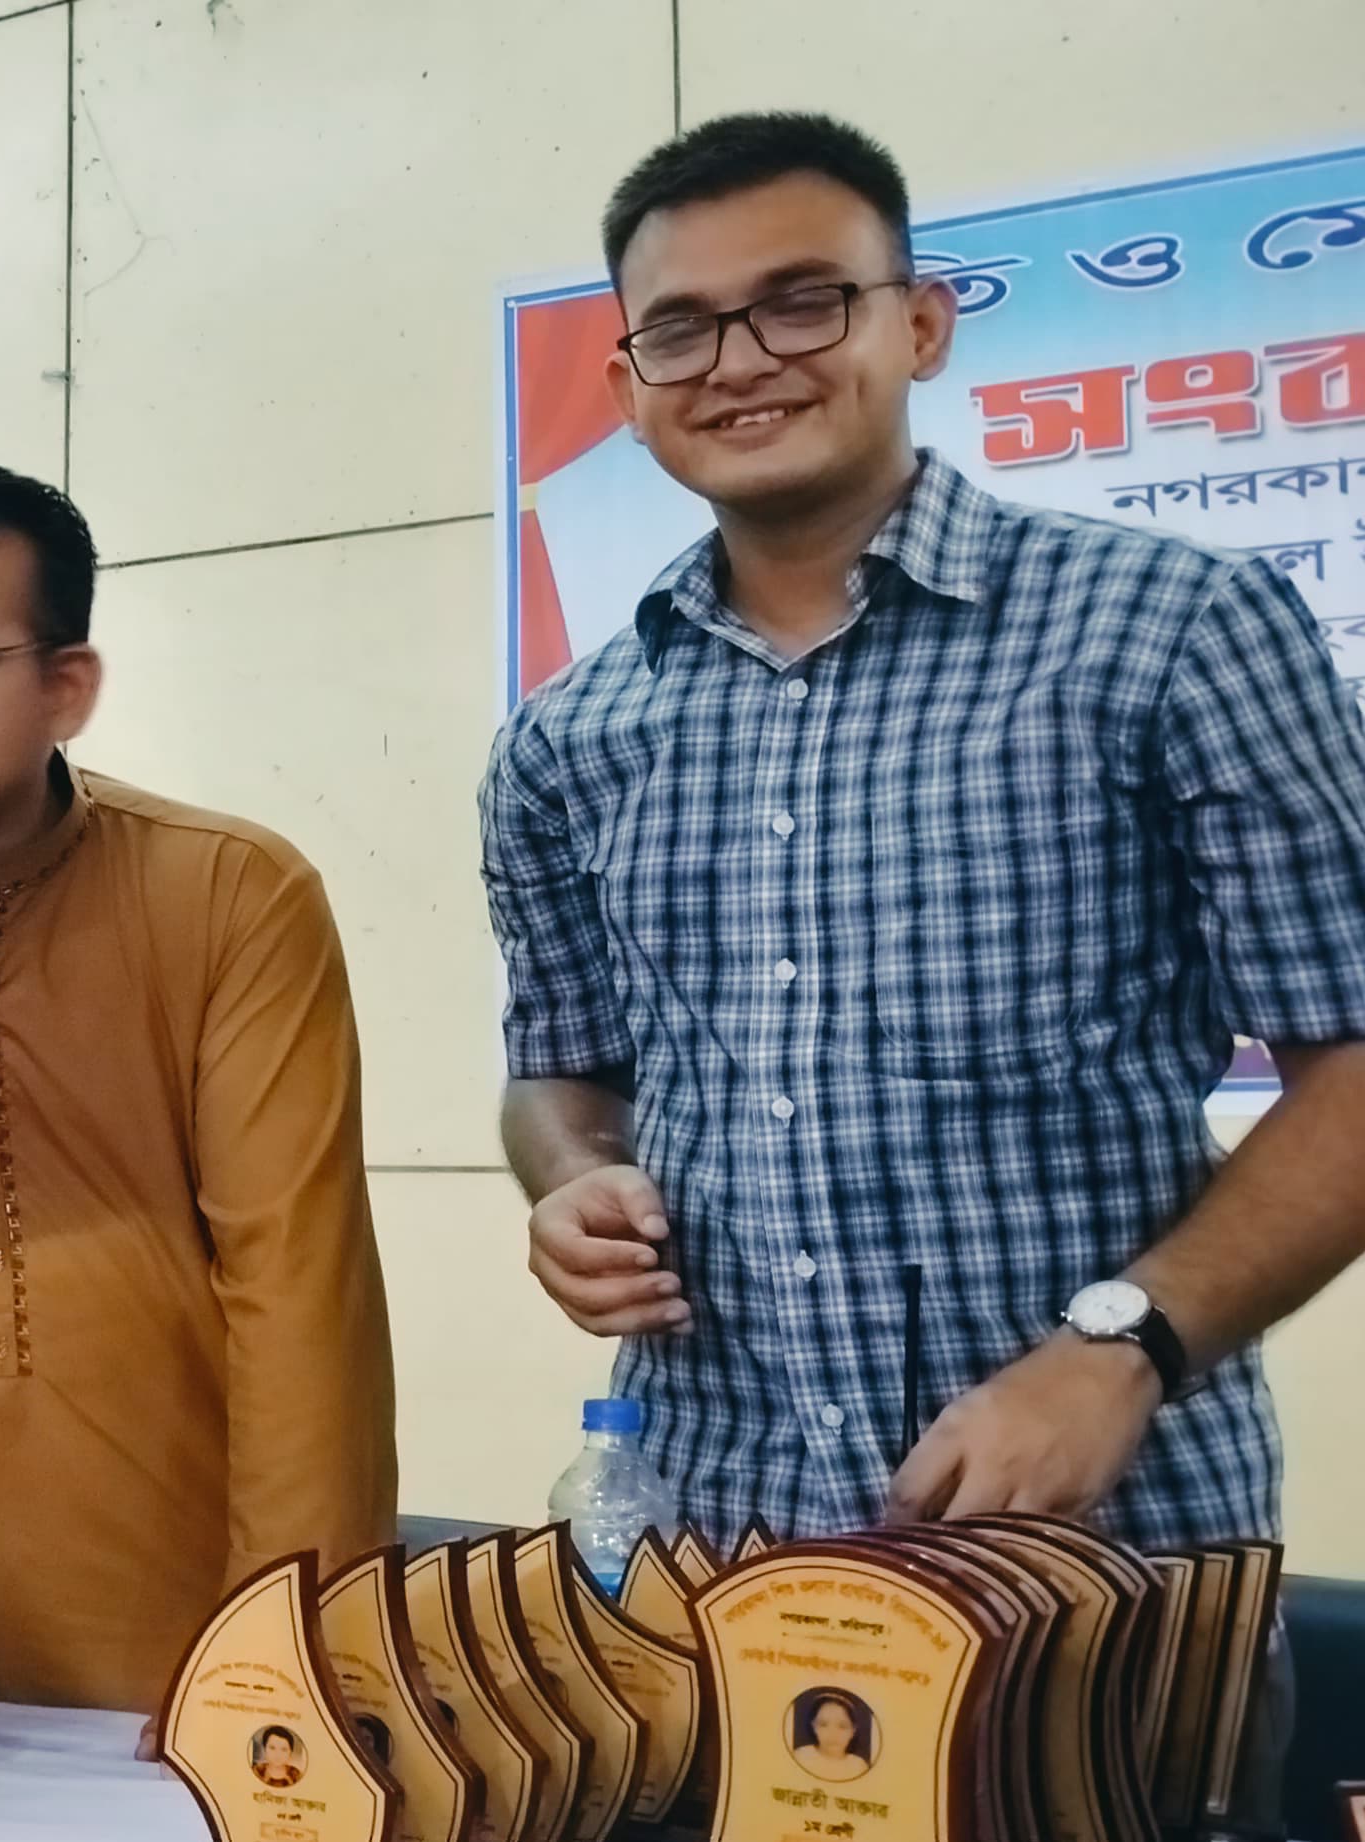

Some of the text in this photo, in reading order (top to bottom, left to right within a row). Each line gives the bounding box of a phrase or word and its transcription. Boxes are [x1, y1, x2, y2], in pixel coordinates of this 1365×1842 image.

[913, 253, 1027, 316] তি
[1069, 235, 1183, 288] ও
[969, 333, 1365, 466] সংব
[1104, 458, 1365, 517] নগরকা
